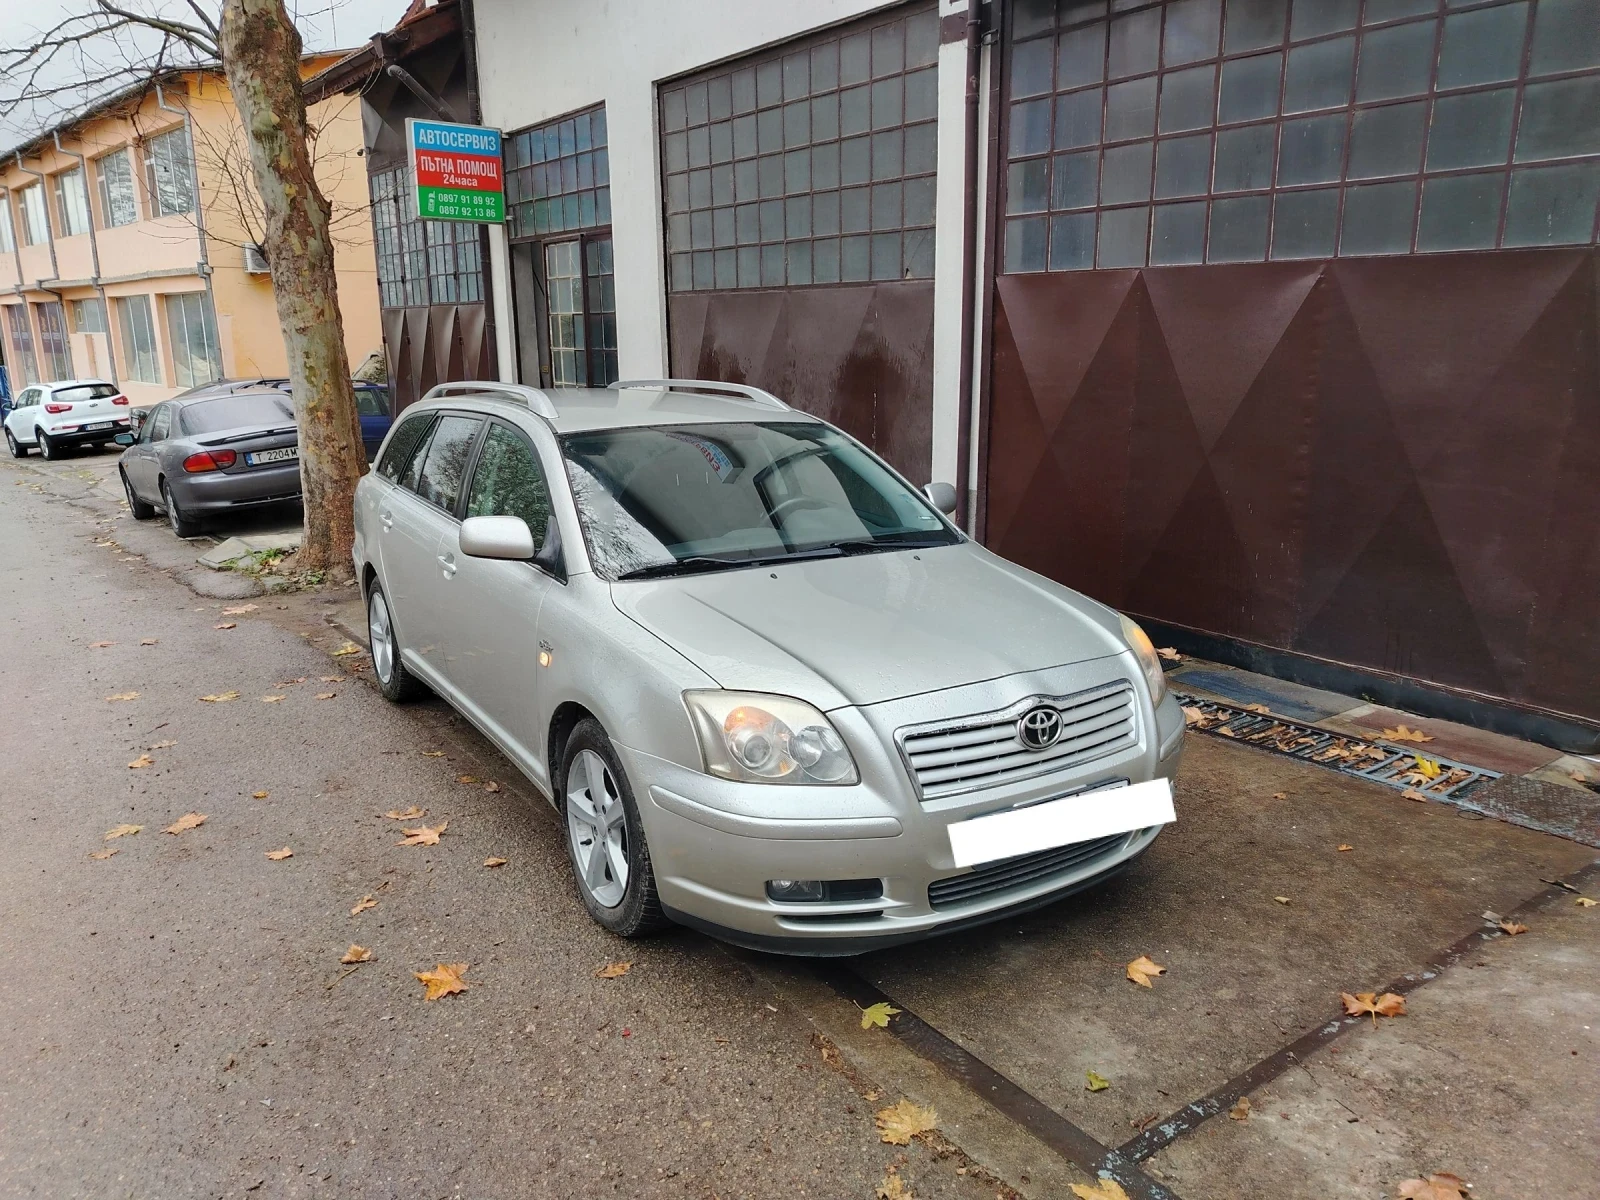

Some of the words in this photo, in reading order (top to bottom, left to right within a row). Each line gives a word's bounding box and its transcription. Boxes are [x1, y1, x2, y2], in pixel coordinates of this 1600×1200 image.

[419, 128, 496, 151] АВТОСЕРВИЗ
[420, 156, 454, 173] ПЪТНА
[457, 159, 498, 180] ПОМОЩ
[443, 174, 478, 187] 24часа
[438, 193, 458, 203] 0897
[461, 194, 470, 204] 91
[473, 195, 483, 205] 89
[485, 196, 495, 206] 92
[439, 205, 459, 215] 0897
[461, 207, 472, 216] 92
[474, 208, 484, 217] 13
[486, 209, 496, 218] 86
